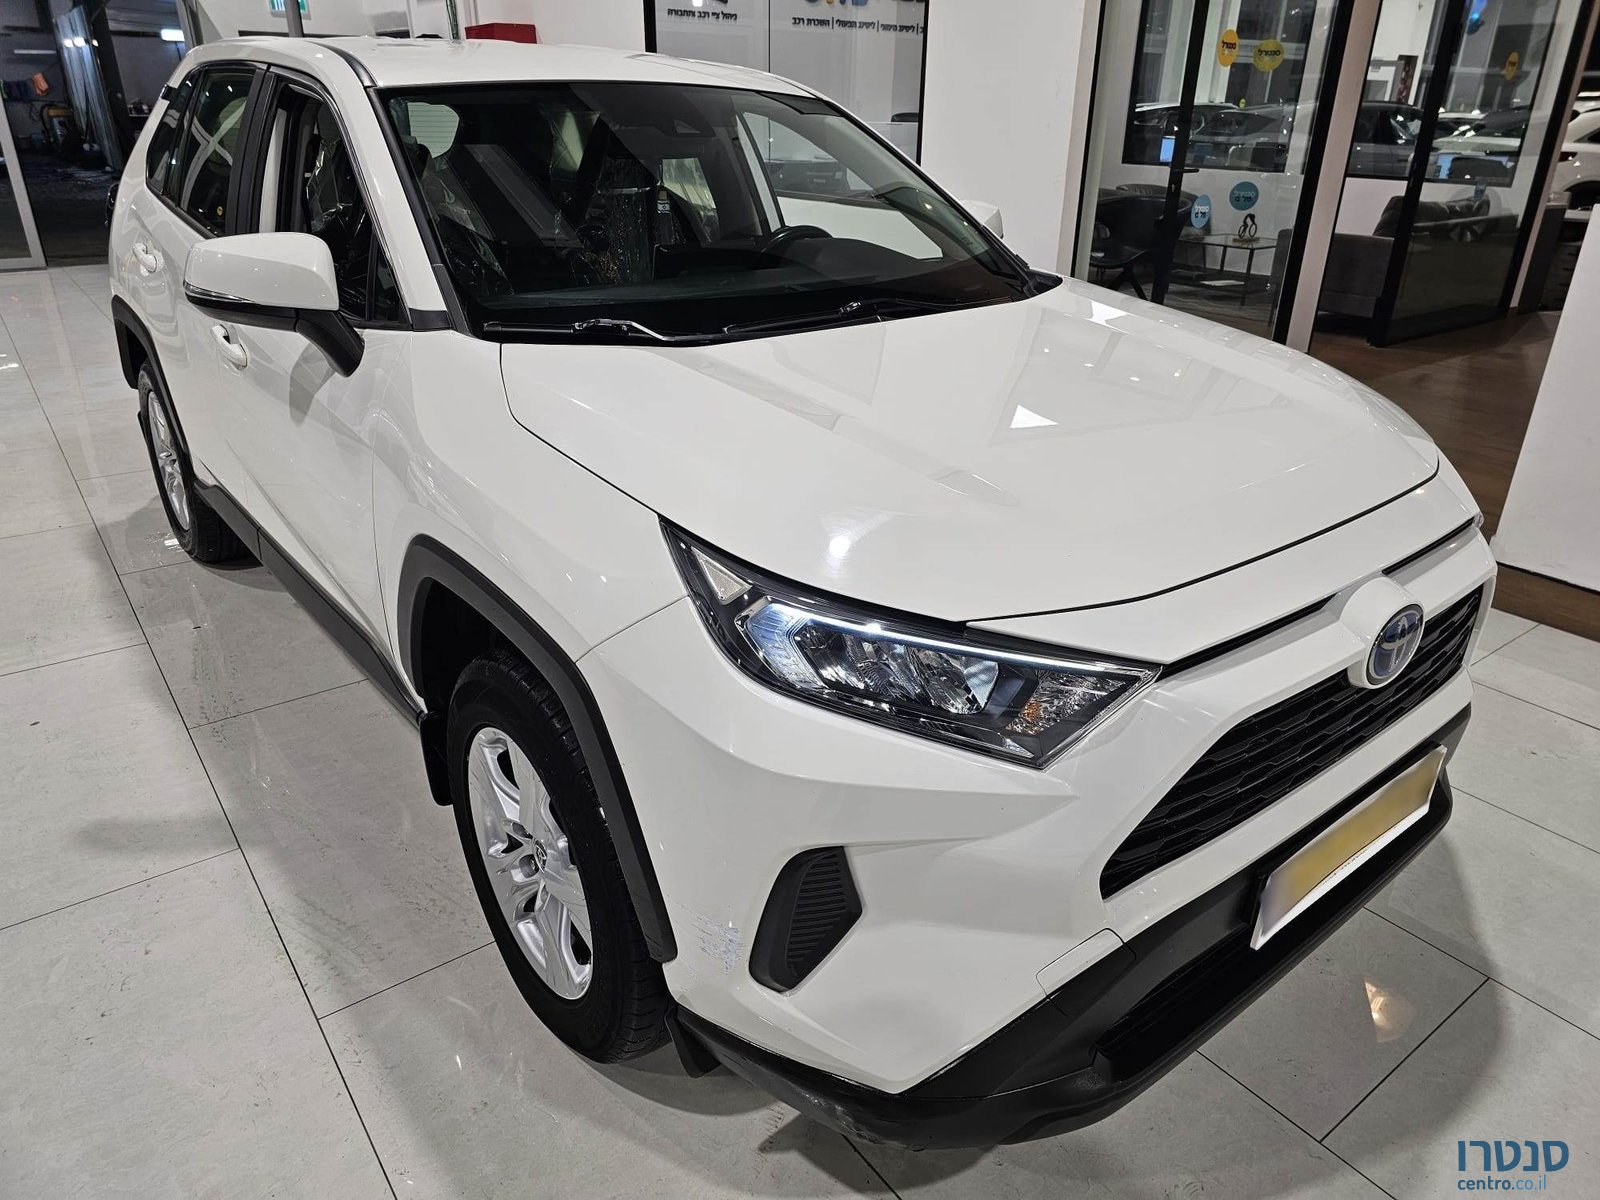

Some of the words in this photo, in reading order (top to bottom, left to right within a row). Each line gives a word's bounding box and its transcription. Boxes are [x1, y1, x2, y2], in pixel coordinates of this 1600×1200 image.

[697, 11, 710, 19] רכב
[792, 17, 805, 26] רכב
[806, 18, 831, 28] השכרת
